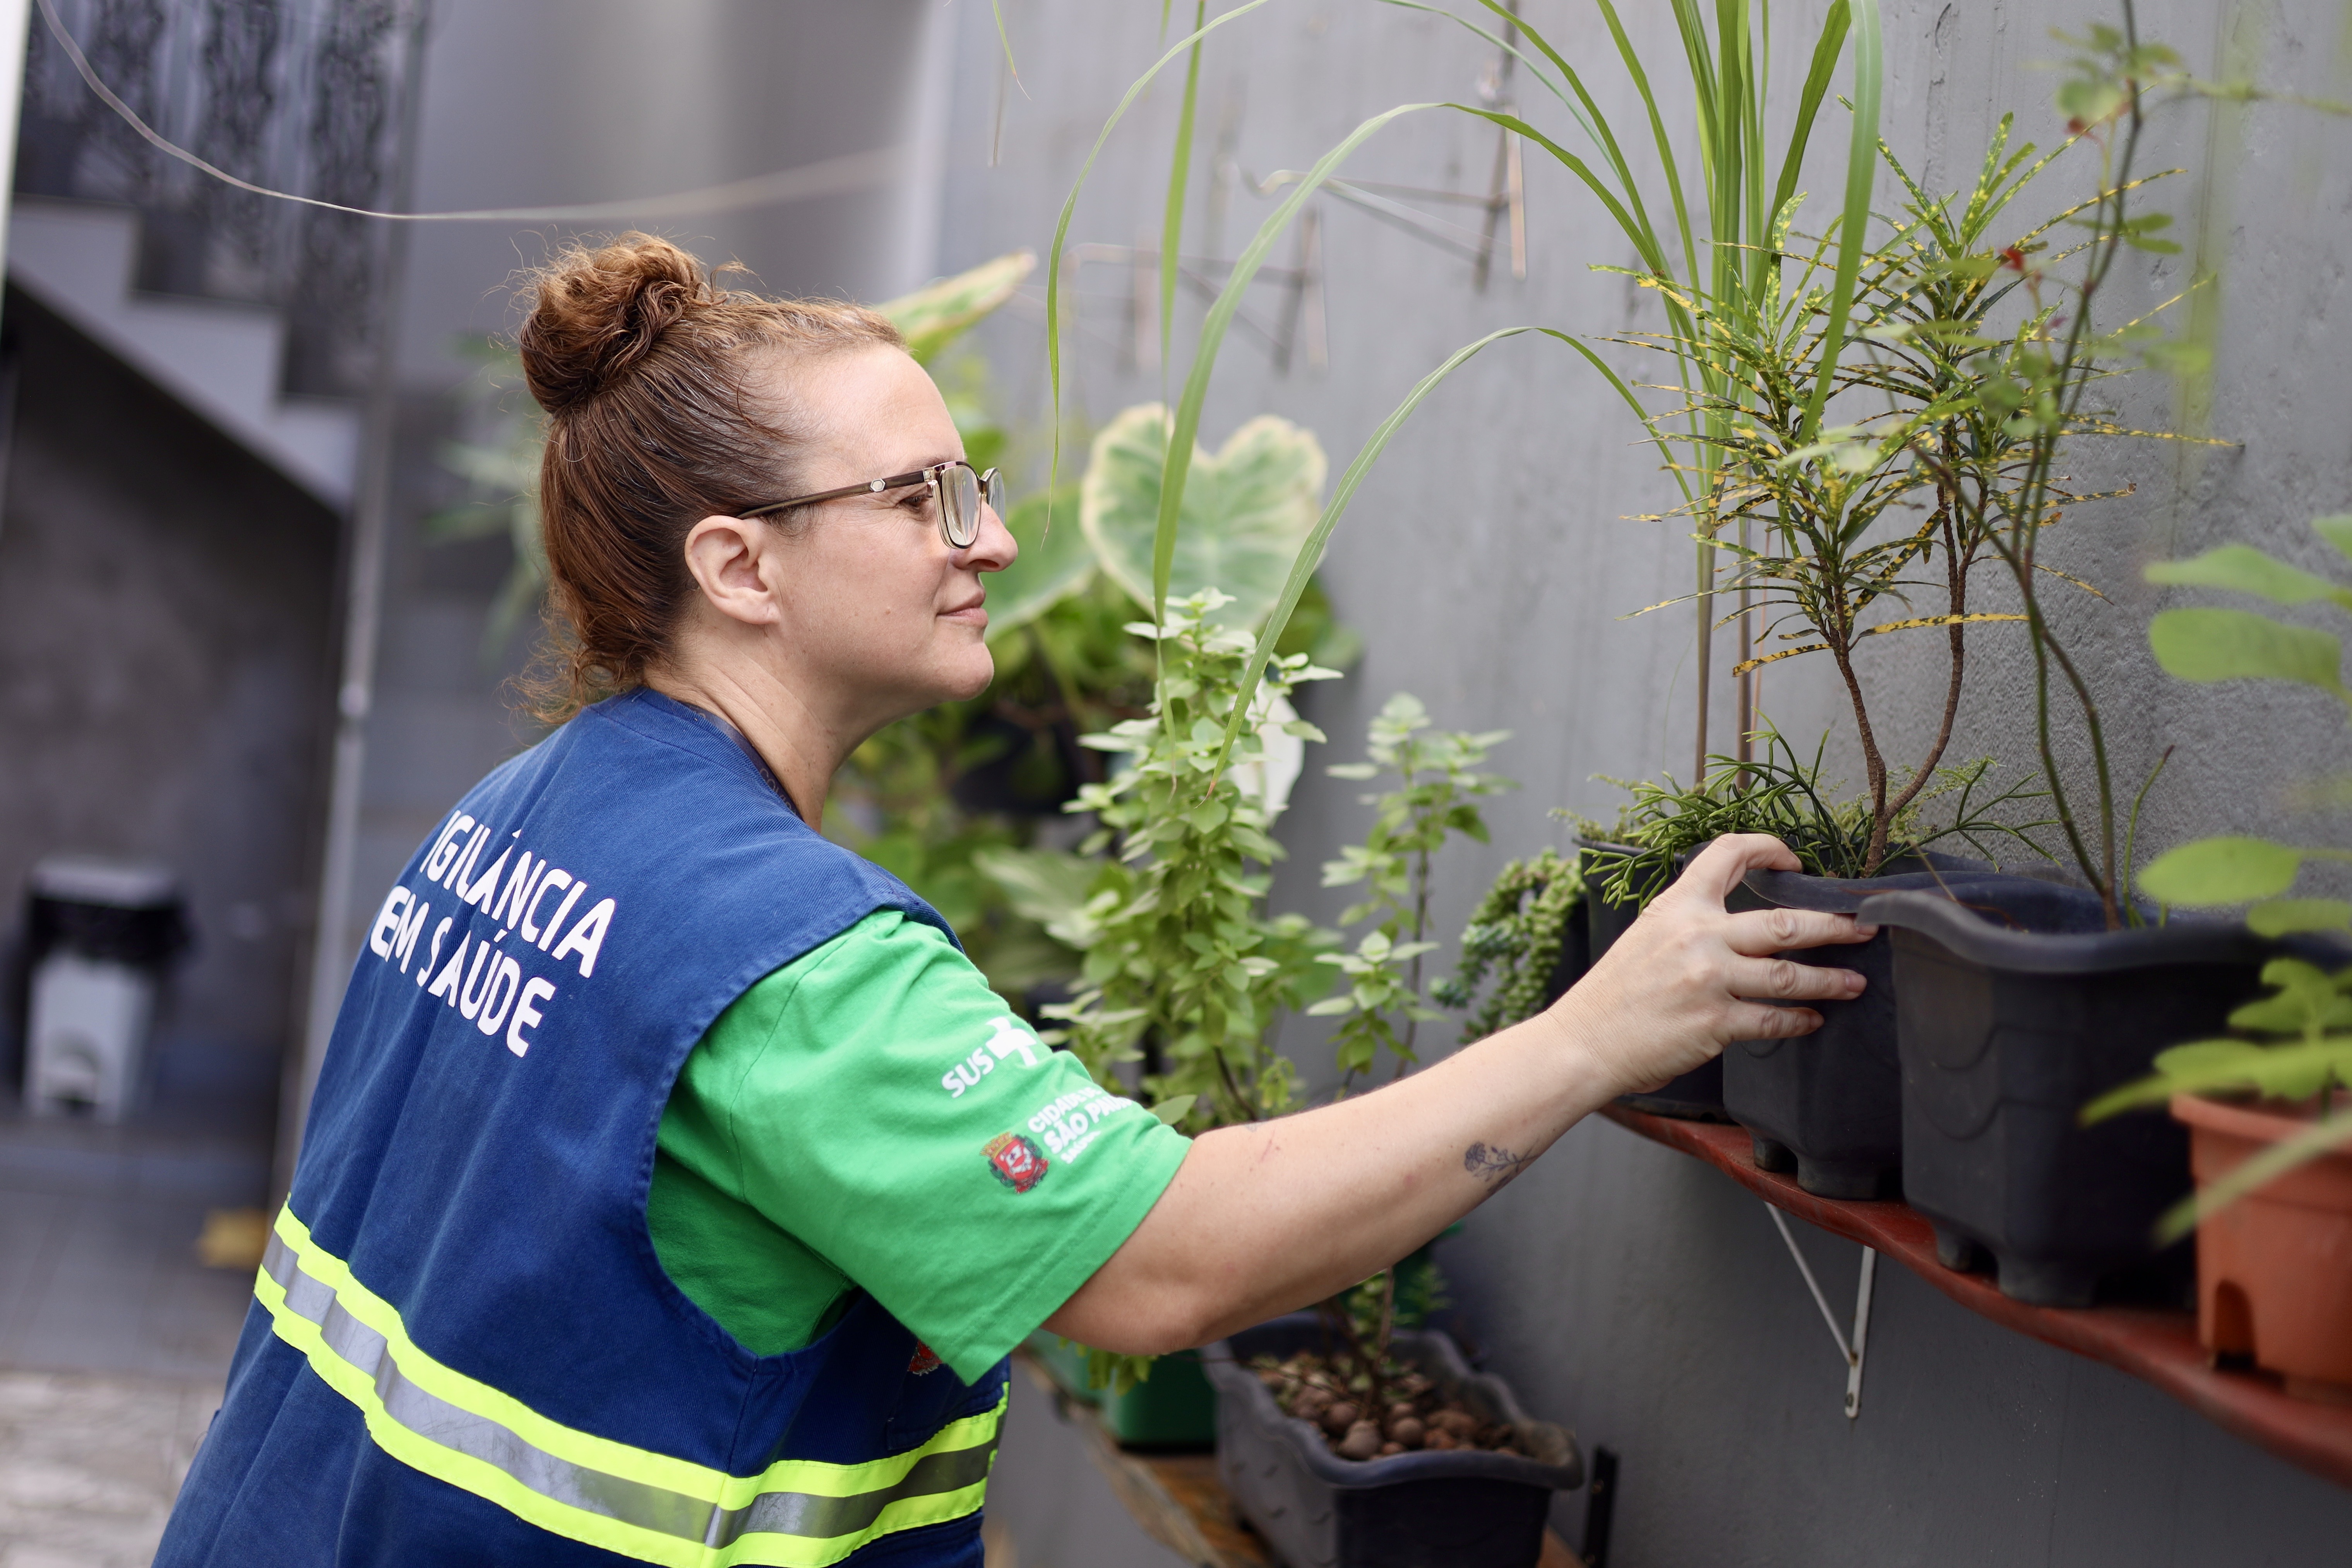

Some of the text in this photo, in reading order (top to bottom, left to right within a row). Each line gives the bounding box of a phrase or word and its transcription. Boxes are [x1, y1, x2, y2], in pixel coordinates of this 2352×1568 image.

[420, 810, 616, 978] IGILÂNCIA
[370, 885, 556, 1058] EM SAÚDE
[941, 1047, 994, 1099] SUS
[1028, 1092, 1087, 1133] CIDADE
[1043, 1118, 1089, 1154] SÃO
